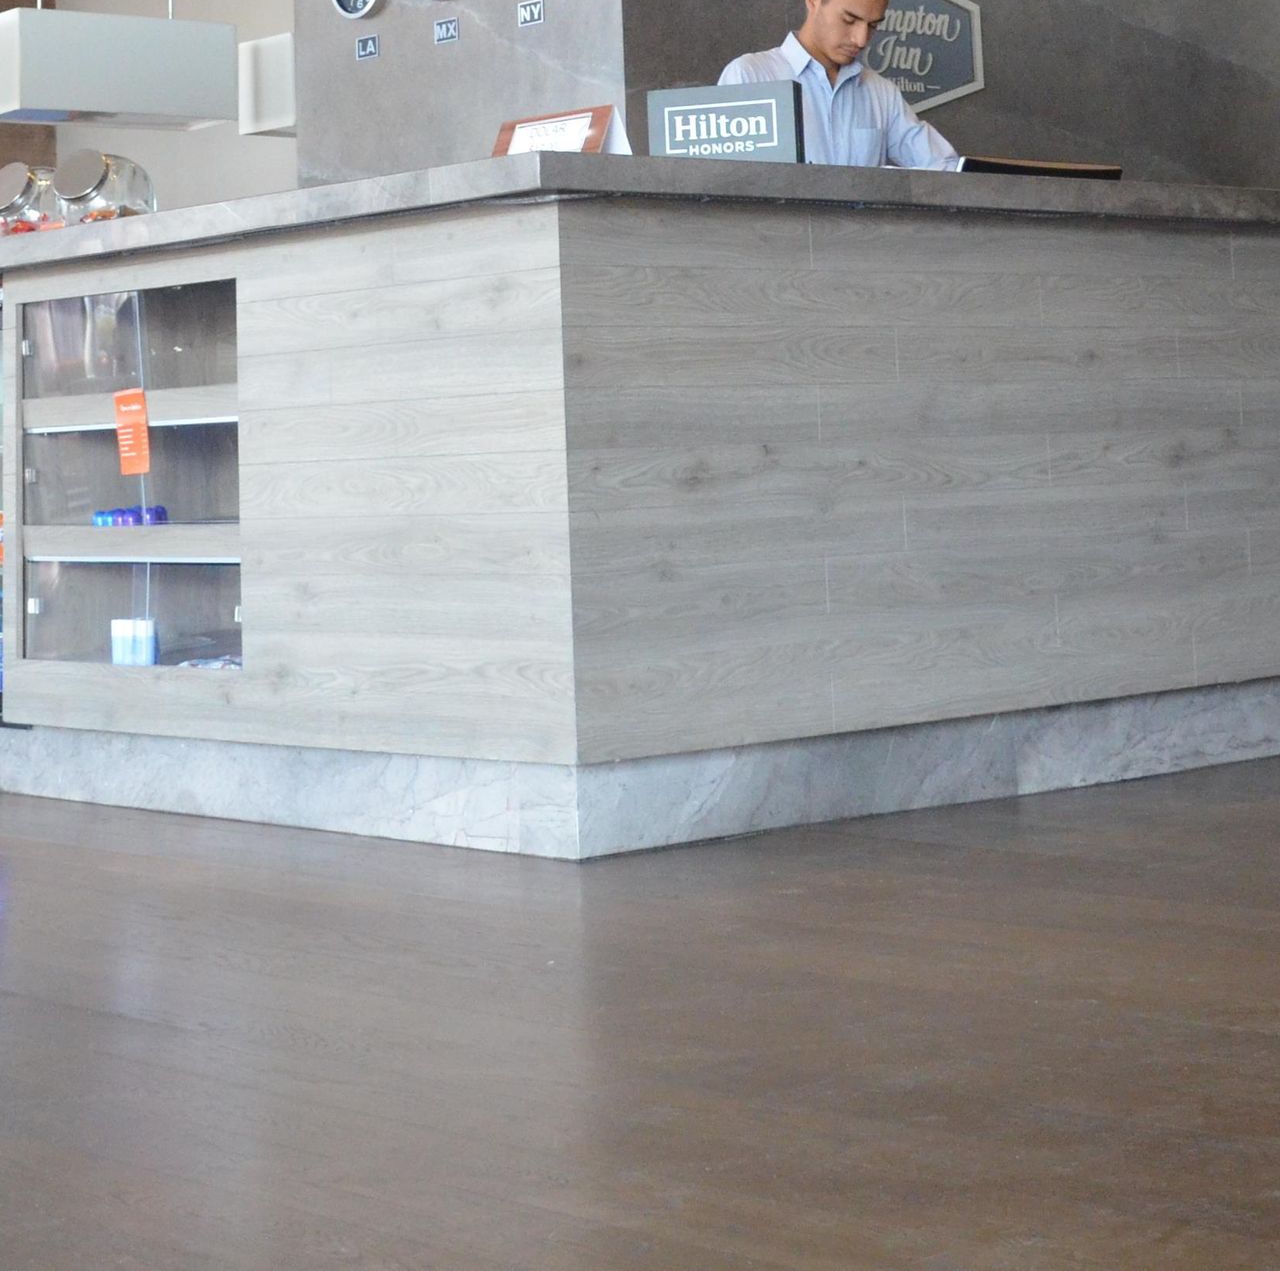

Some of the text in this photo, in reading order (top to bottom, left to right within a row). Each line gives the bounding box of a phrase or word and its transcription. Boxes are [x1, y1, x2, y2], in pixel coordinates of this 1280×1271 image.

[520, 3, 541, 22] NY
[436, 22, 456, 39] MX
[877, 5, 960, 42] mpton
[358, 39, 376, 56] LA
[864, 35, 933, 76] Inn
[893, 76, 925, 93] ilton
[673, 113, 768, 141] Hilton
[689, 140, 755, 156] HONORS
